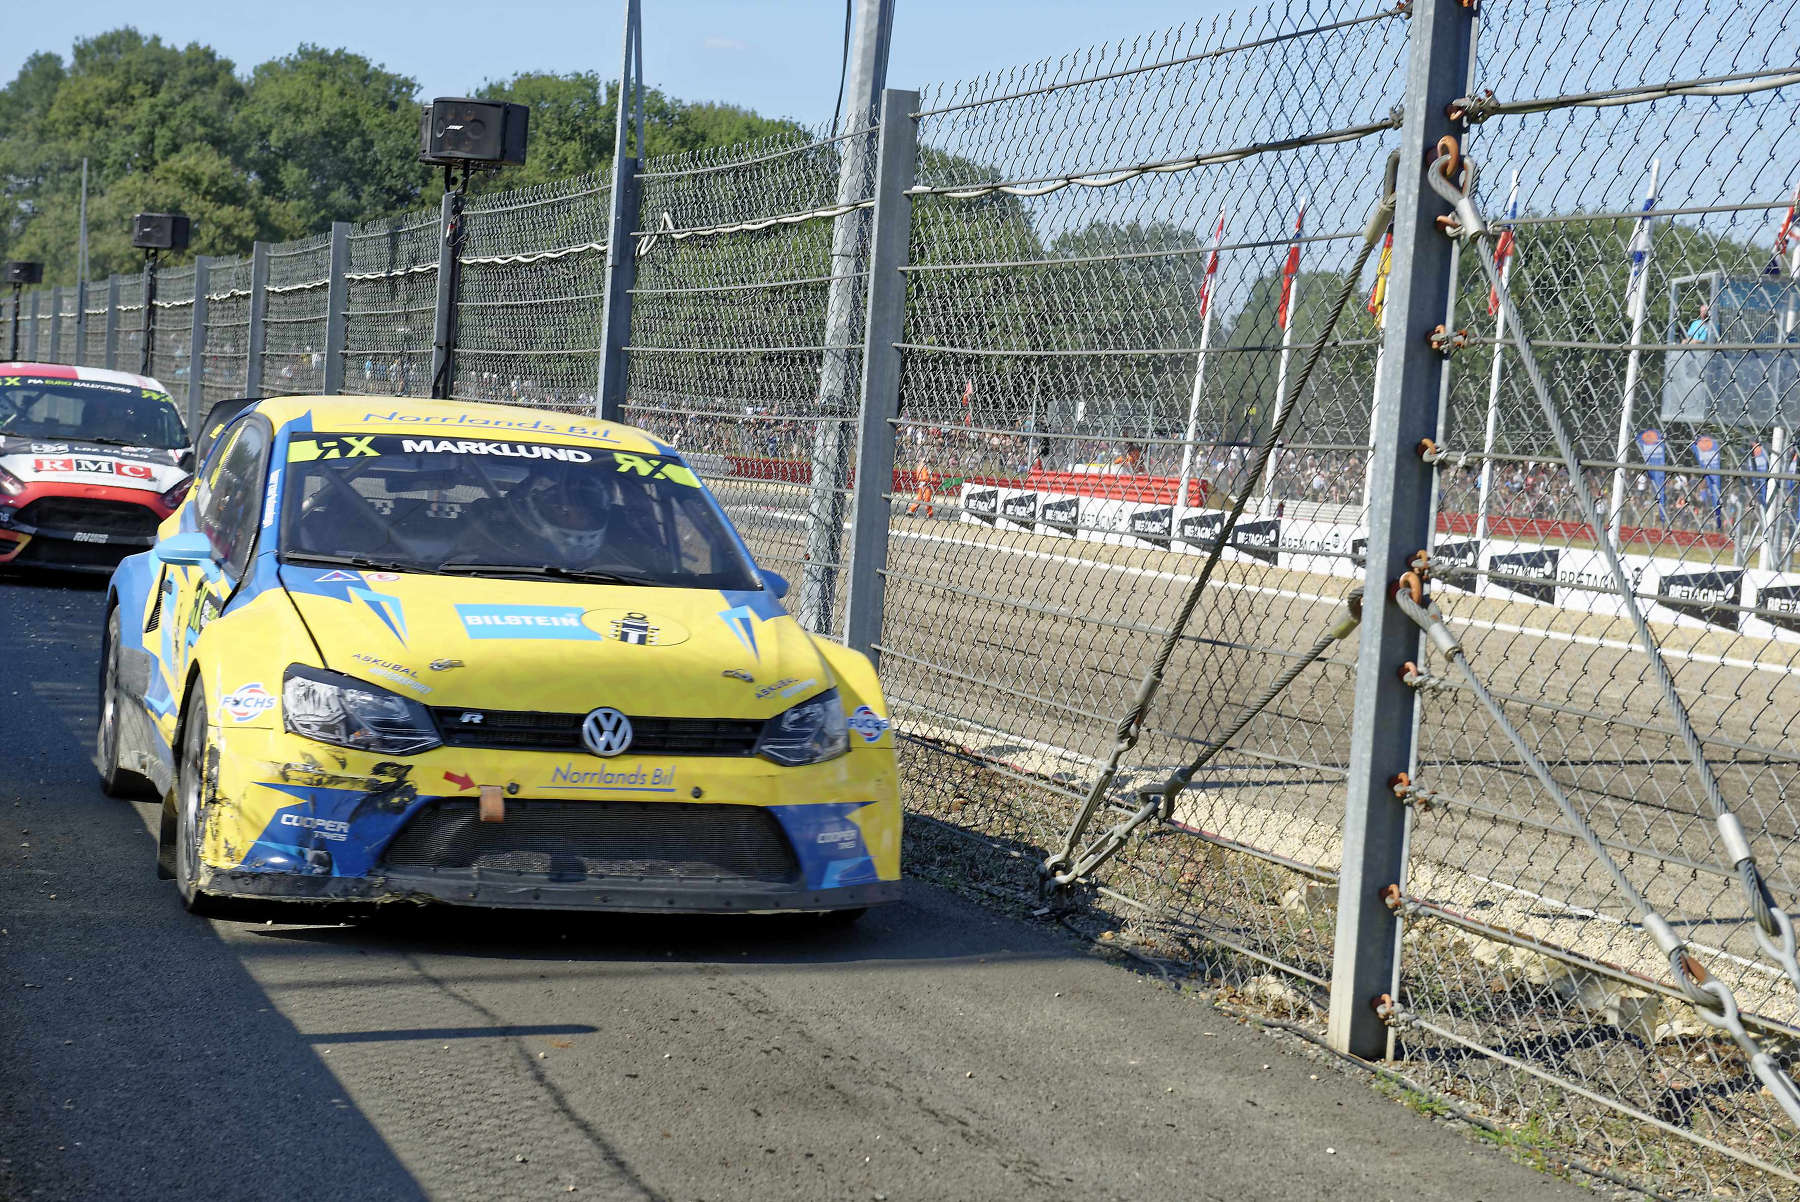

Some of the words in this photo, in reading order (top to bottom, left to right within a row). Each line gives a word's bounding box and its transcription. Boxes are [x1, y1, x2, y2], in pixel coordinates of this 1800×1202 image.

[361, 411, 556, 431] Norrlands
[569, 426, 612, 438] Bil
[401, 439, 592, 463] MARKLUND
[38, 459, 152, 479] RMC
[1560, 573, 1620, 591] BRETAGN
[1668, 584, 1727, 603] BRETAGNE
[464, 615, 580, 627] BILSTEIN
[223, 697, 276, 709] FUCHS
[847, 718, 889, 730] FUCHS
[551, 762, 647, 785] Norrlands
[651, 765, 677, 785] Bil
[280, 814, 351, 833] COOPER
